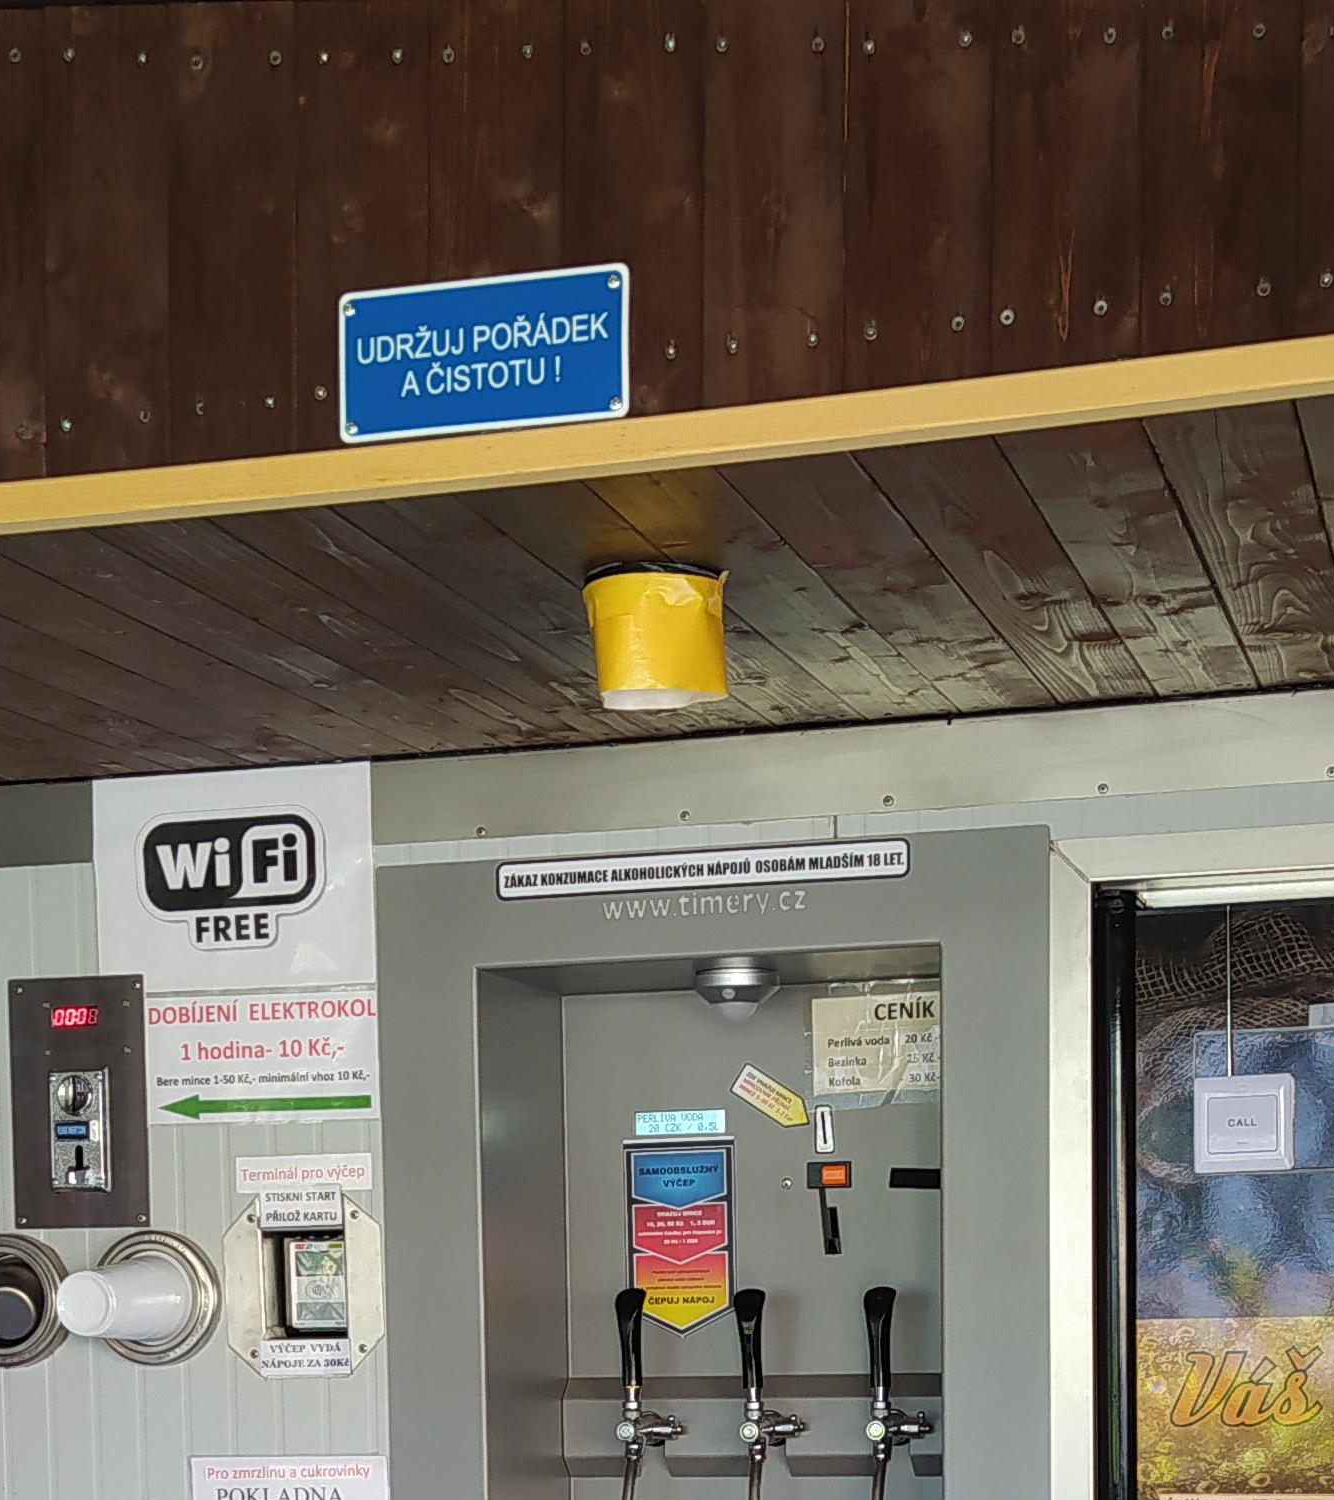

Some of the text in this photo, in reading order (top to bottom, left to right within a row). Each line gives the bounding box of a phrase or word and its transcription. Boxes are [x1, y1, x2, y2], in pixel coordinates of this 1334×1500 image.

[356, 312, 608, 364] UDRŽUJ POŘÁDEK
[401, 371, 420, 397] A
[426, 358, 545, 395] ČISTOTU
[504, 852, 905, 888] ZÁKAZ KONZUMACE ALKOHOLICKÝCH NÁPOJŮ OSOBÁM MLADŠÍM 18 LET.
[603, 890, 807, 920] www.timery.cz
[195, 913, 270, 943] FREE
[148, 999, 376, 1025] DOBÍJENÍ ELEKTROKOL
[874, 996, 935, 1021] CENÍK
[828, 1037, 862, 1048] Perlivá
[865, 1036, 890, 1045] voda
[905, 1034, 917, 1043] 20
[180, 1043, 191, 1060] 1
[279, 1039, 302, 1057] 10
[828, 1056, 866, 1067] Bezinka
[157, 1075, 179, 1086] Bere
[182, 1075, 211, 1085] mince
[214, 1075, 235, 1085] 1-50
[312, 1071, 334, 1081] vhoz
[338, 1071, 349, 1080] 10
[829, 1076, 861, 1087] Kofola
[909, 1074, 921, 1082] 30
[637, 1113, 704, 1123] PERLIVA VODA
[1228, 1118, 1257, 1127] CALL
[649, 1125, 659, 1133] 20
[665, 1123, 681, 1132] CZK
[240, 1164, 365, 1181] Terminál pro výčep
[265, 1192, 336, 1202] STISKNI START
[265, 1210, 337, 1222] PŘILOŽ KARTU
[648, 1296, 679, 1305] ČEPUJ
[270, 1342, 341, 1354] VÝČEP VYDÁ
[262, 1358, 305, 1368] NÁPOJE
[307, 1359, 321, 1367] ZA
[1170, 1344, 1324, 1427] Váš
[207, 1464, 370, 1480] Pro zmrzlinu a cukrovinky
